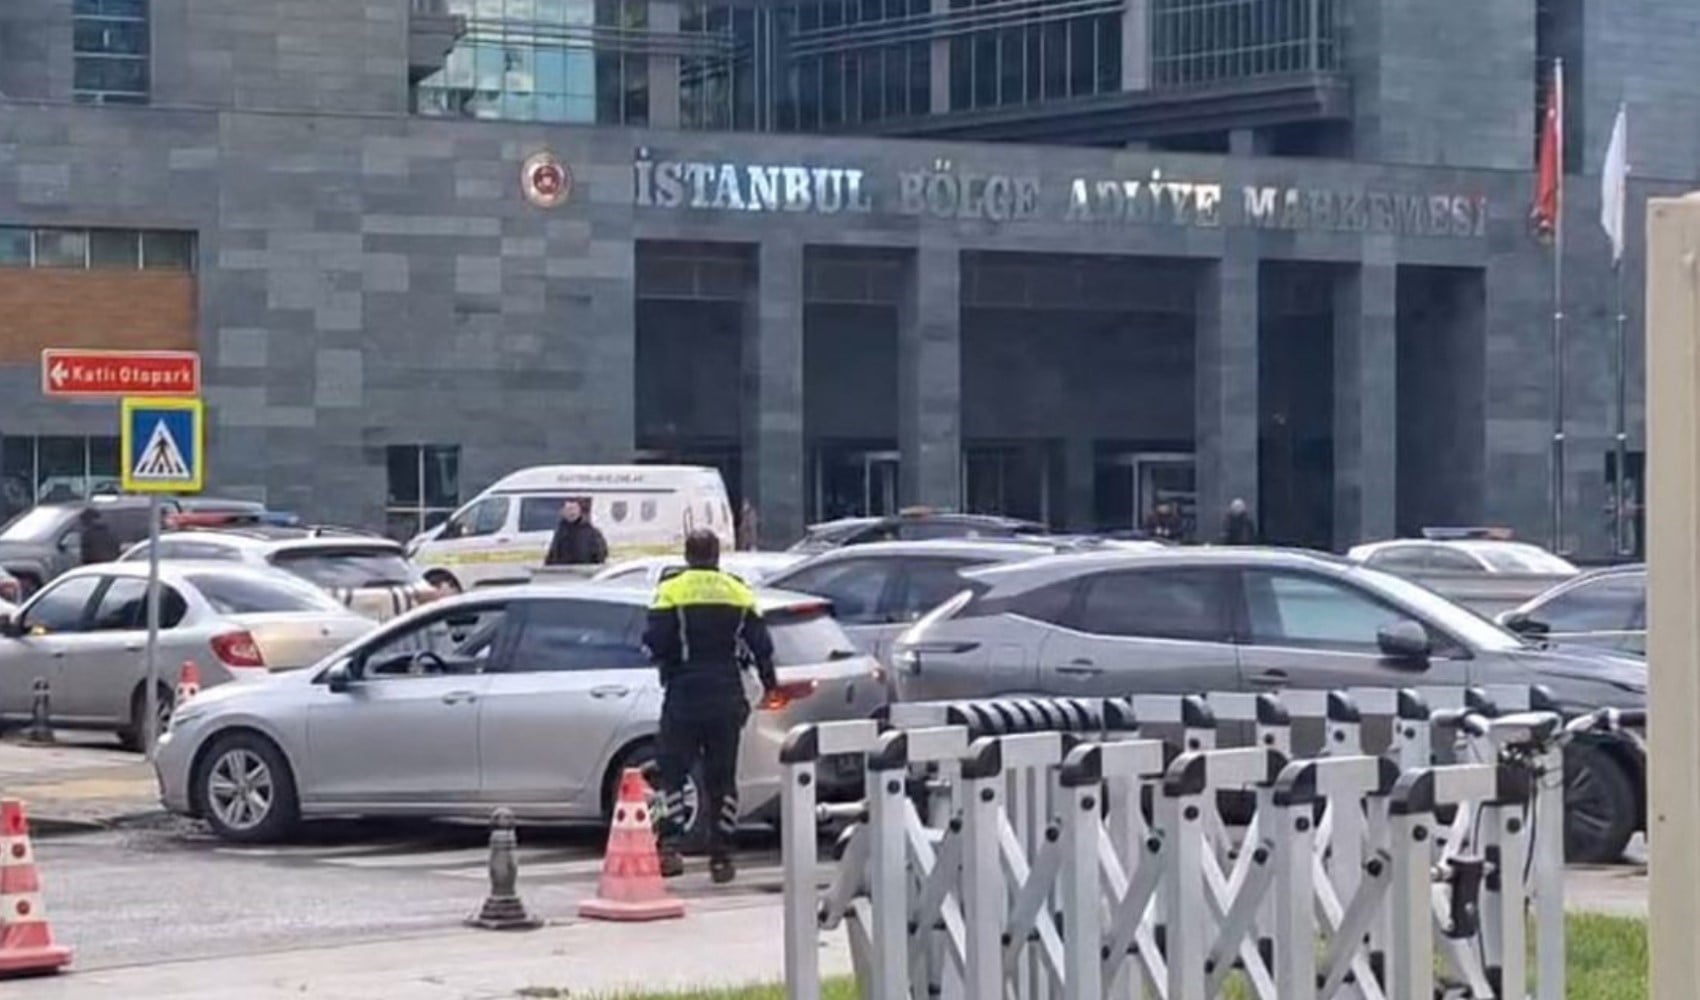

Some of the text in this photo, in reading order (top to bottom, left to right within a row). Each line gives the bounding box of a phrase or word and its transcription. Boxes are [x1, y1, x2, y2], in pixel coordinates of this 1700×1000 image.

[634, 146, 871, 213] İSTANBUL
[900, 159, 1040, 220] BÖLGE
[1065, 168, 1221, 227] ADLİYE
[119, 366, 192, 386] Otopark
